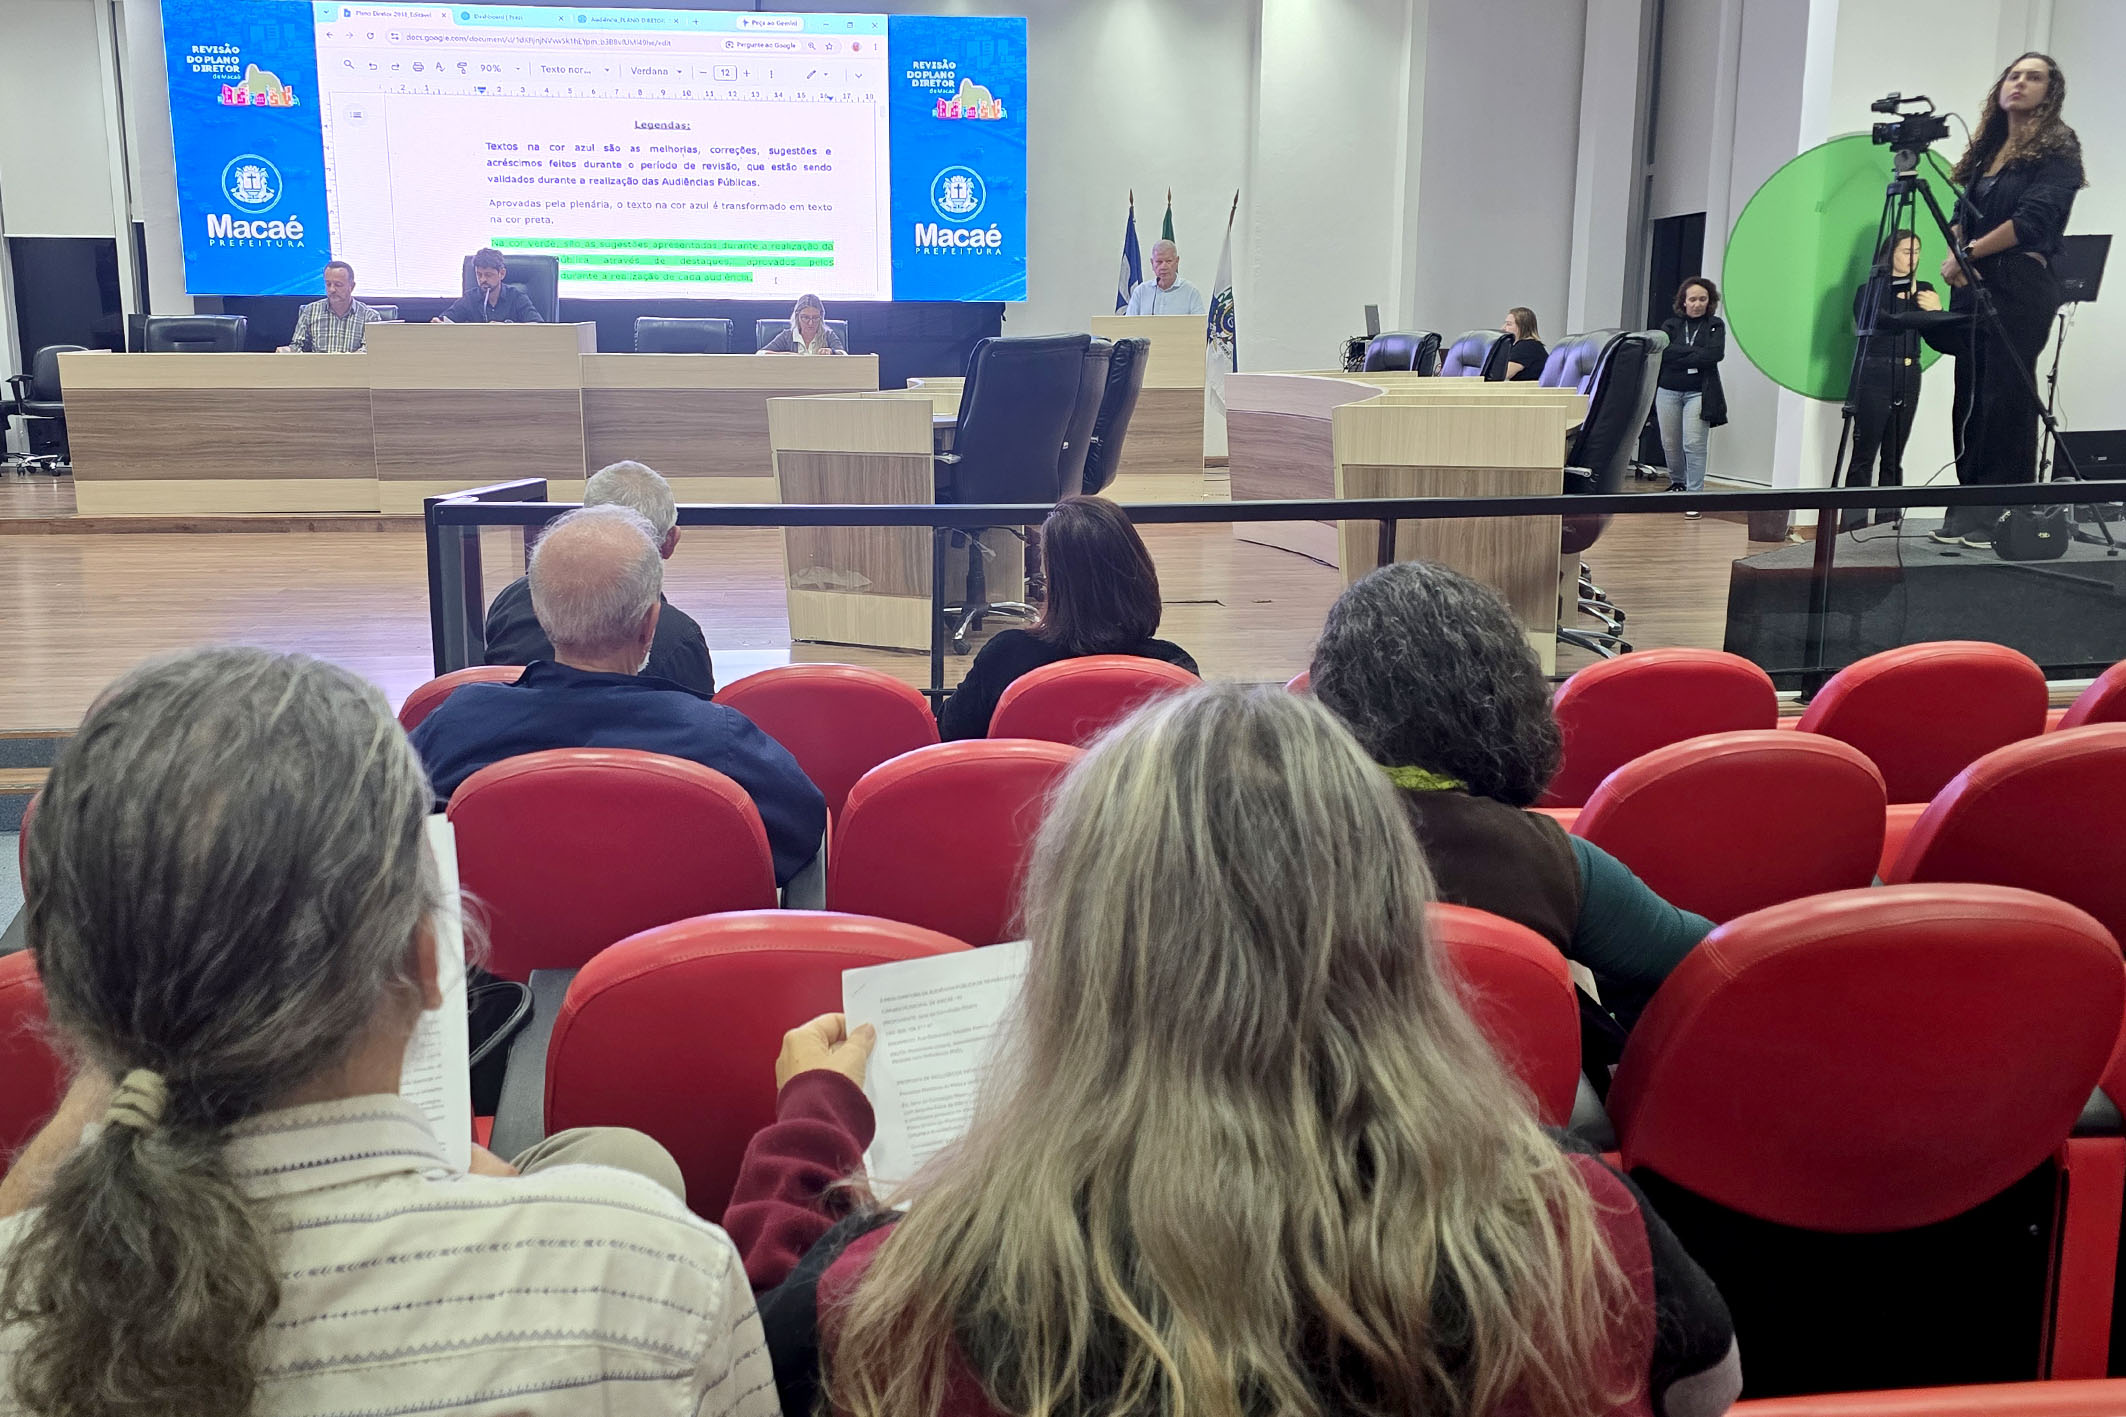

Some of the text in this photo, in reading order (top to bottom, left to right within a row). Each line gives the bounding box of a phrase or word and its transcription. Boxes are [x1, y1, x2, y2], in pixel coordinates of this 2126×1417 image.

[191, 43, 240, 55] REVISÃO
[774, 42, 796, 50] Google
[186, 55, 240, 64] DO PLANO
[192, 64, 240, 73] DIRETOR
[480, 64, 502, 73] 90%
[913, 59, 956, 70] REVISÃO
[540, 65, 566, 74] Texto
[631, 66, 669, 76] Verdana
[720, 68, 731, 77] 12
[906, 70, 955, 79] DO PLANO
[911, 79, 955, 88] DIRETOR
[486, 142, 518, 151] Textos
[575, 143, 595, 152] azul
[604, 144, 620, 152] são
[630, 145, 640, 153] as
[650, 145, 701, 154] melhorias,
[710, 146, 760, 156] correções,
[769, 147, 817, 157] sugestões
[487, 157, 542, 167] acréscimos
[549, 159, 577, 168] feitos
[584, 160, 622, 169] durante
[640, 160, 677, 171] período
[684, 161, 696, 170] de
[702, 162, 740, 172] revisão,
[747, 163, 765, 173] que
[771, 162, 797, 171] estão
[803, 163, 832, 171] sendo
[487, 175, 534, 184] validados
[538, 175, 576, 184] durante
[589, 176, 639, 187] realização
[641, 177, 659, 185] das
[661, 177, 715, 186] Audiências
[718, 178, 760, 187] Públicas.
[489, 199, 541, 210] Aprovadas
[545, 200, 566, 210] pela
[570, 200, 612, 210] plenária,
[627, 201, 652, 209] texto
[690, 201, 709, 210] azul
[713, 201, 718, 210] é
[722, 202, 786, 211] transformado
[808, 203, 832, 211] texto
[506, 216, 520, 224] cor
[207, 213, 304, 239] Macaé
[915, 223, 1002, 248] Macaé
[209, 239, 304, 248] PREFEITURA
[491, 239, 504, 247] Na
[600, 240, 648, 249] sugestões
[653, 241, 717, 250] apresentadas
[722, 242, 758, 250] durante
[771, 243, 818, 251] realização
[915, 247, 1002, 255] PREFEITURA
[560, 255, 589, 264] ública
[603, 256, 640, 264] através
[747, 259, 796, 267] aprovados
[809, 258, 834, 267] pelos
[560, 272, 598, 280] durante
[663, 273, 675, 281] de
